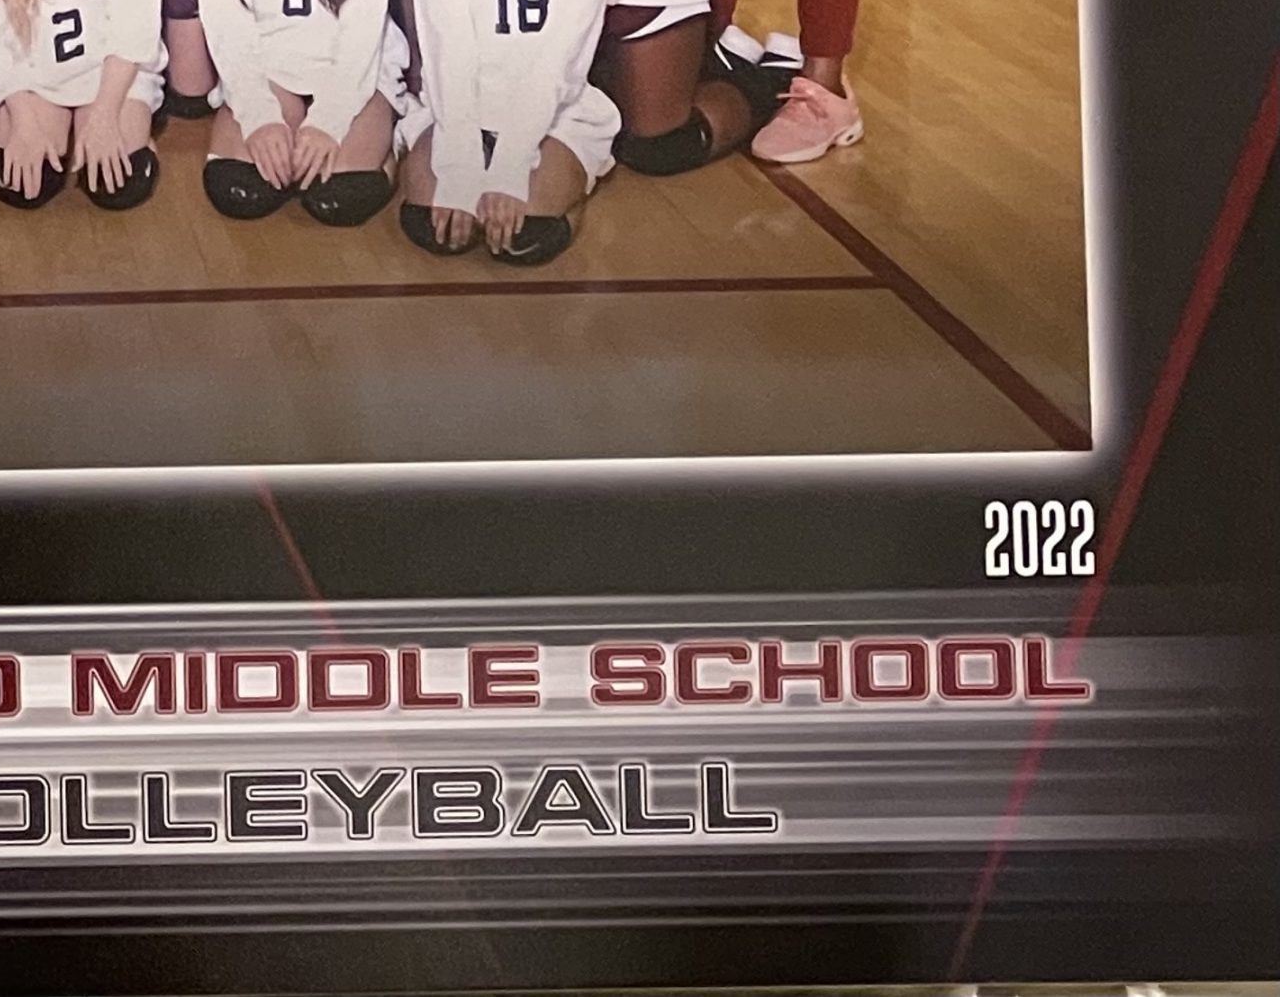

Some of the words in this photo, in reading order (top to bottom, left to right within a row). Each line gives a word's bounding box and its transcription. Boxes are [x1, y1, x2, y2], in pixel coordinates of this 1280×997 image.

[51, 8, 85, 64] 2
[984, 500, 1096, 577] 2022
[71, 644, 540, 716] MIDDLE
[591, 635, 1092, 704] SCHOOL
